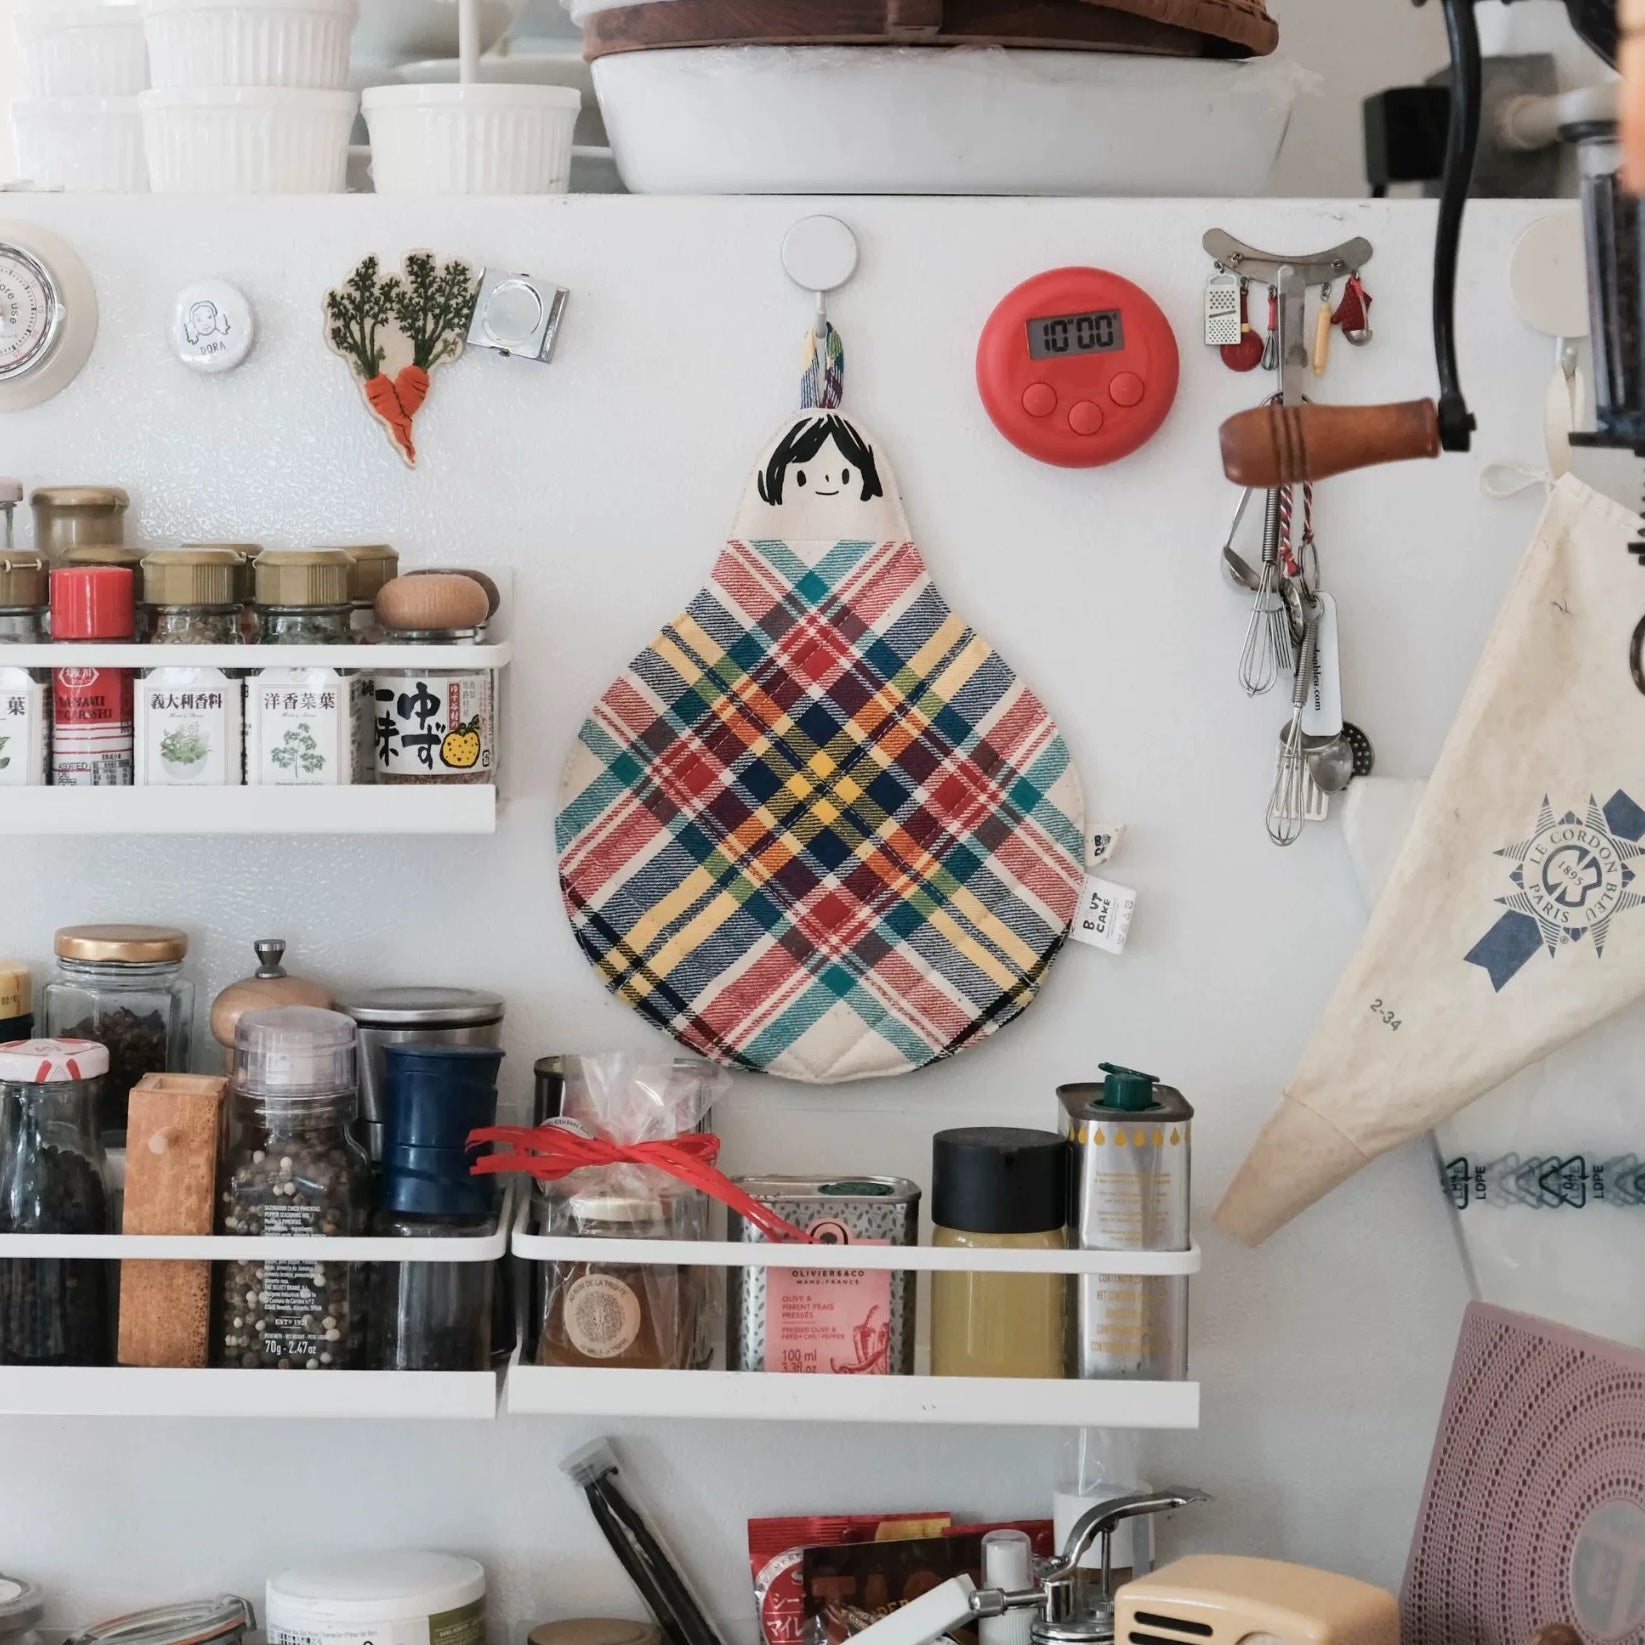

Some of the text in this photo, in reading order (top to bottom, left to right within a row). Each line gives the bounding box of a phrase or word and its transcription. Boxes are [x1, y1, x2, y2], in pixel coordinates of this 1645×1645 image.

[200, 341, 226, 355] DORA
[6, 696, 26, 716] 葉
[151, 692, 222, 710] 義大利香料
[264, 692, 336, 710] 洋香菜葉
[397, 682, 446, 770] ゆず
[1530, 829, 1617, 921] LE CORDON BLEU
[1558, 861, 1584, 886] 1895
[1529, 883, 1570, 923] PARIS
[1096, 899, 1110, 933] CAKE
[1370, 998, 1402, 1031] 2-34
[1475, 1166, 1486, 1200] LDPE
[1592, 1165, 1604, 1199] LDPE
[792, 1270, 865, 1278] OLIVIERS&CO
[265, 1340, 281, 1355] 70g
[782, 1349, 817, 1361] 100 ml
